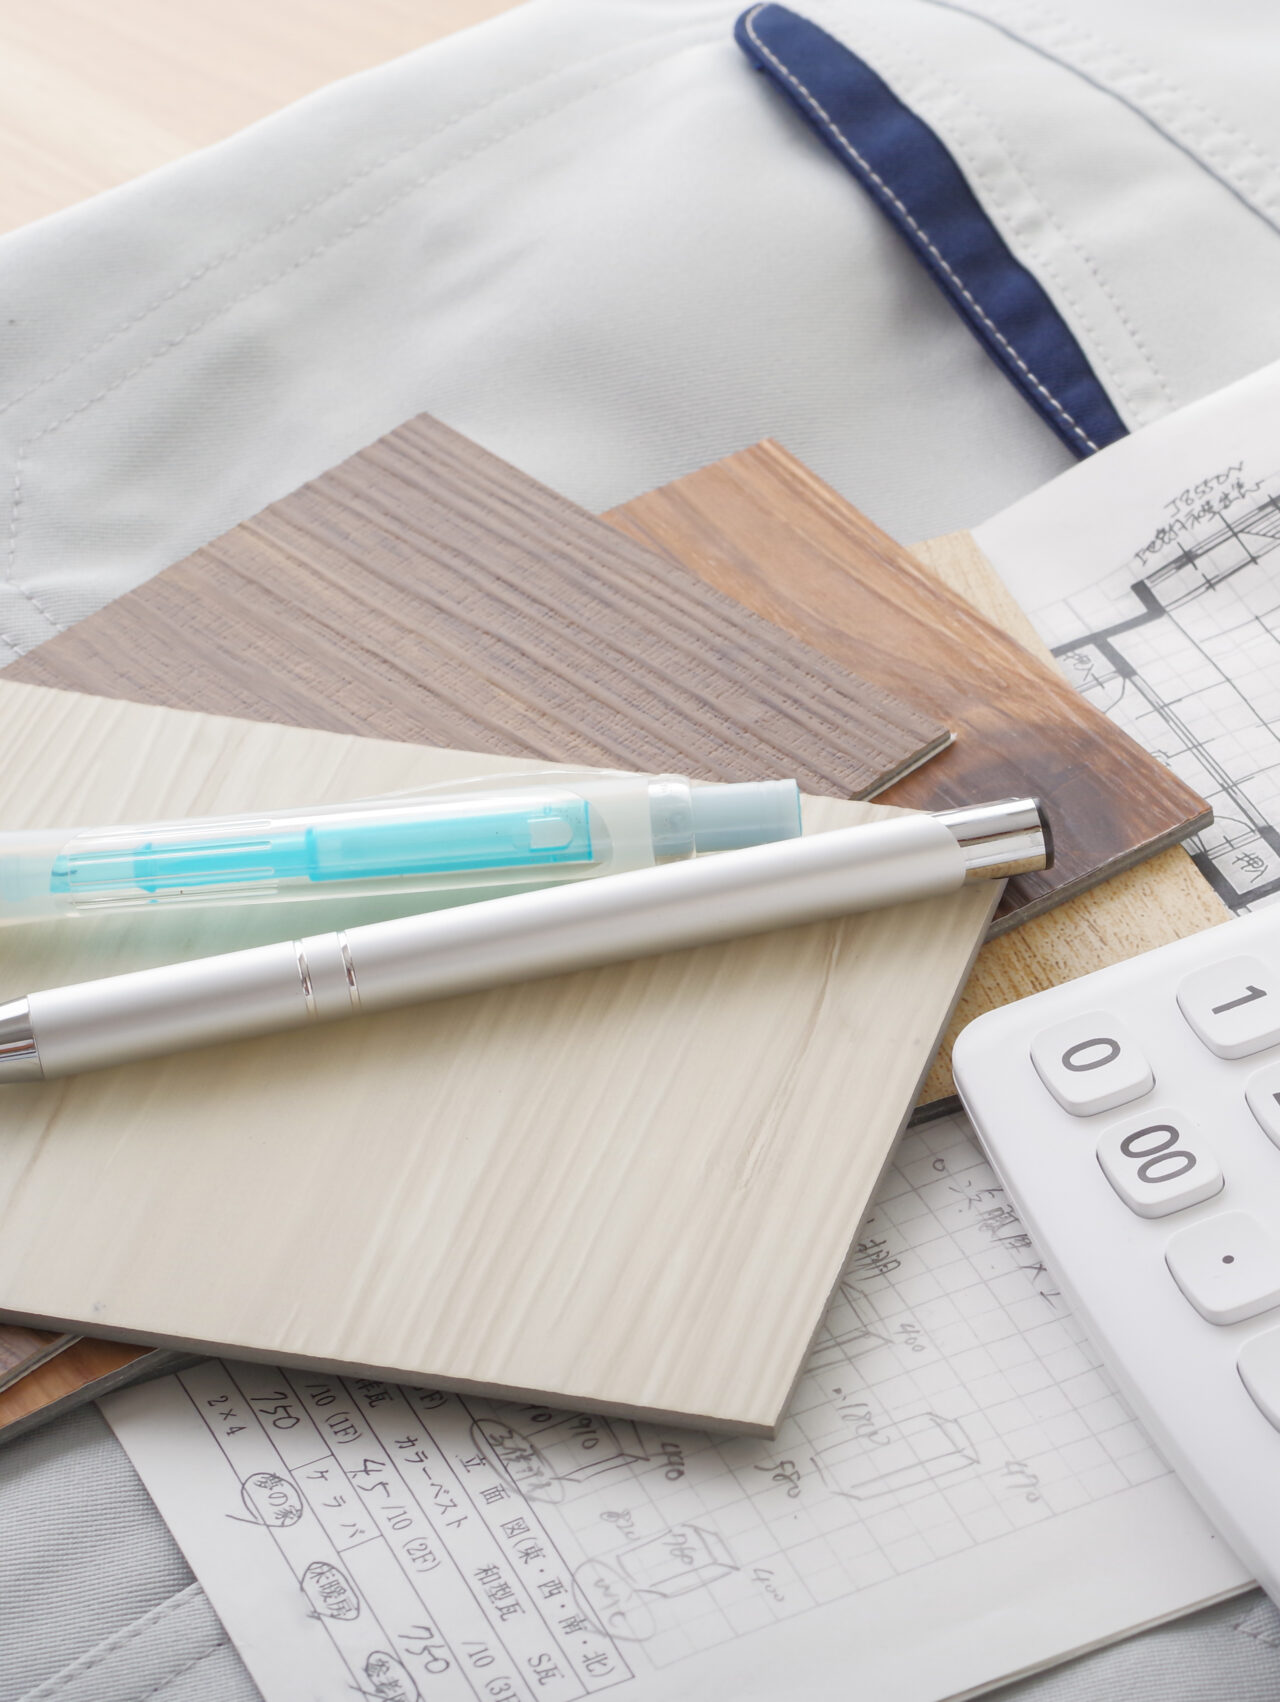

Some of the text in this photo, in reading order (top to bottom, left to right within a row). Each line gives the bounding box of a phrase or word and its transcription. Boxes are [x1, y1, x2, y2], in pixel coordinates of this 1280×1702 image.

[1210, 985, 1267, 1014] 1
[1062, 1037, 1121, 1072] 0
[1120, 1124, 1196, 1184] 00
[250, 1391, 301, 1430] 750
[325, 1411, 363, 1444] (1F)
[381, 1504, 441, 1572] /10 (2F)
[395, 1436, 469, 1530] カラーベスト
[474, 1563, 526, 1622] 和型瓦
[527, 1652, 566, 1687] S瓦
[307, 1562, 359, 1618] 床暖房
[398, 1625, 450, 1674] 750
[461, 1641, 496, 1669] /10
